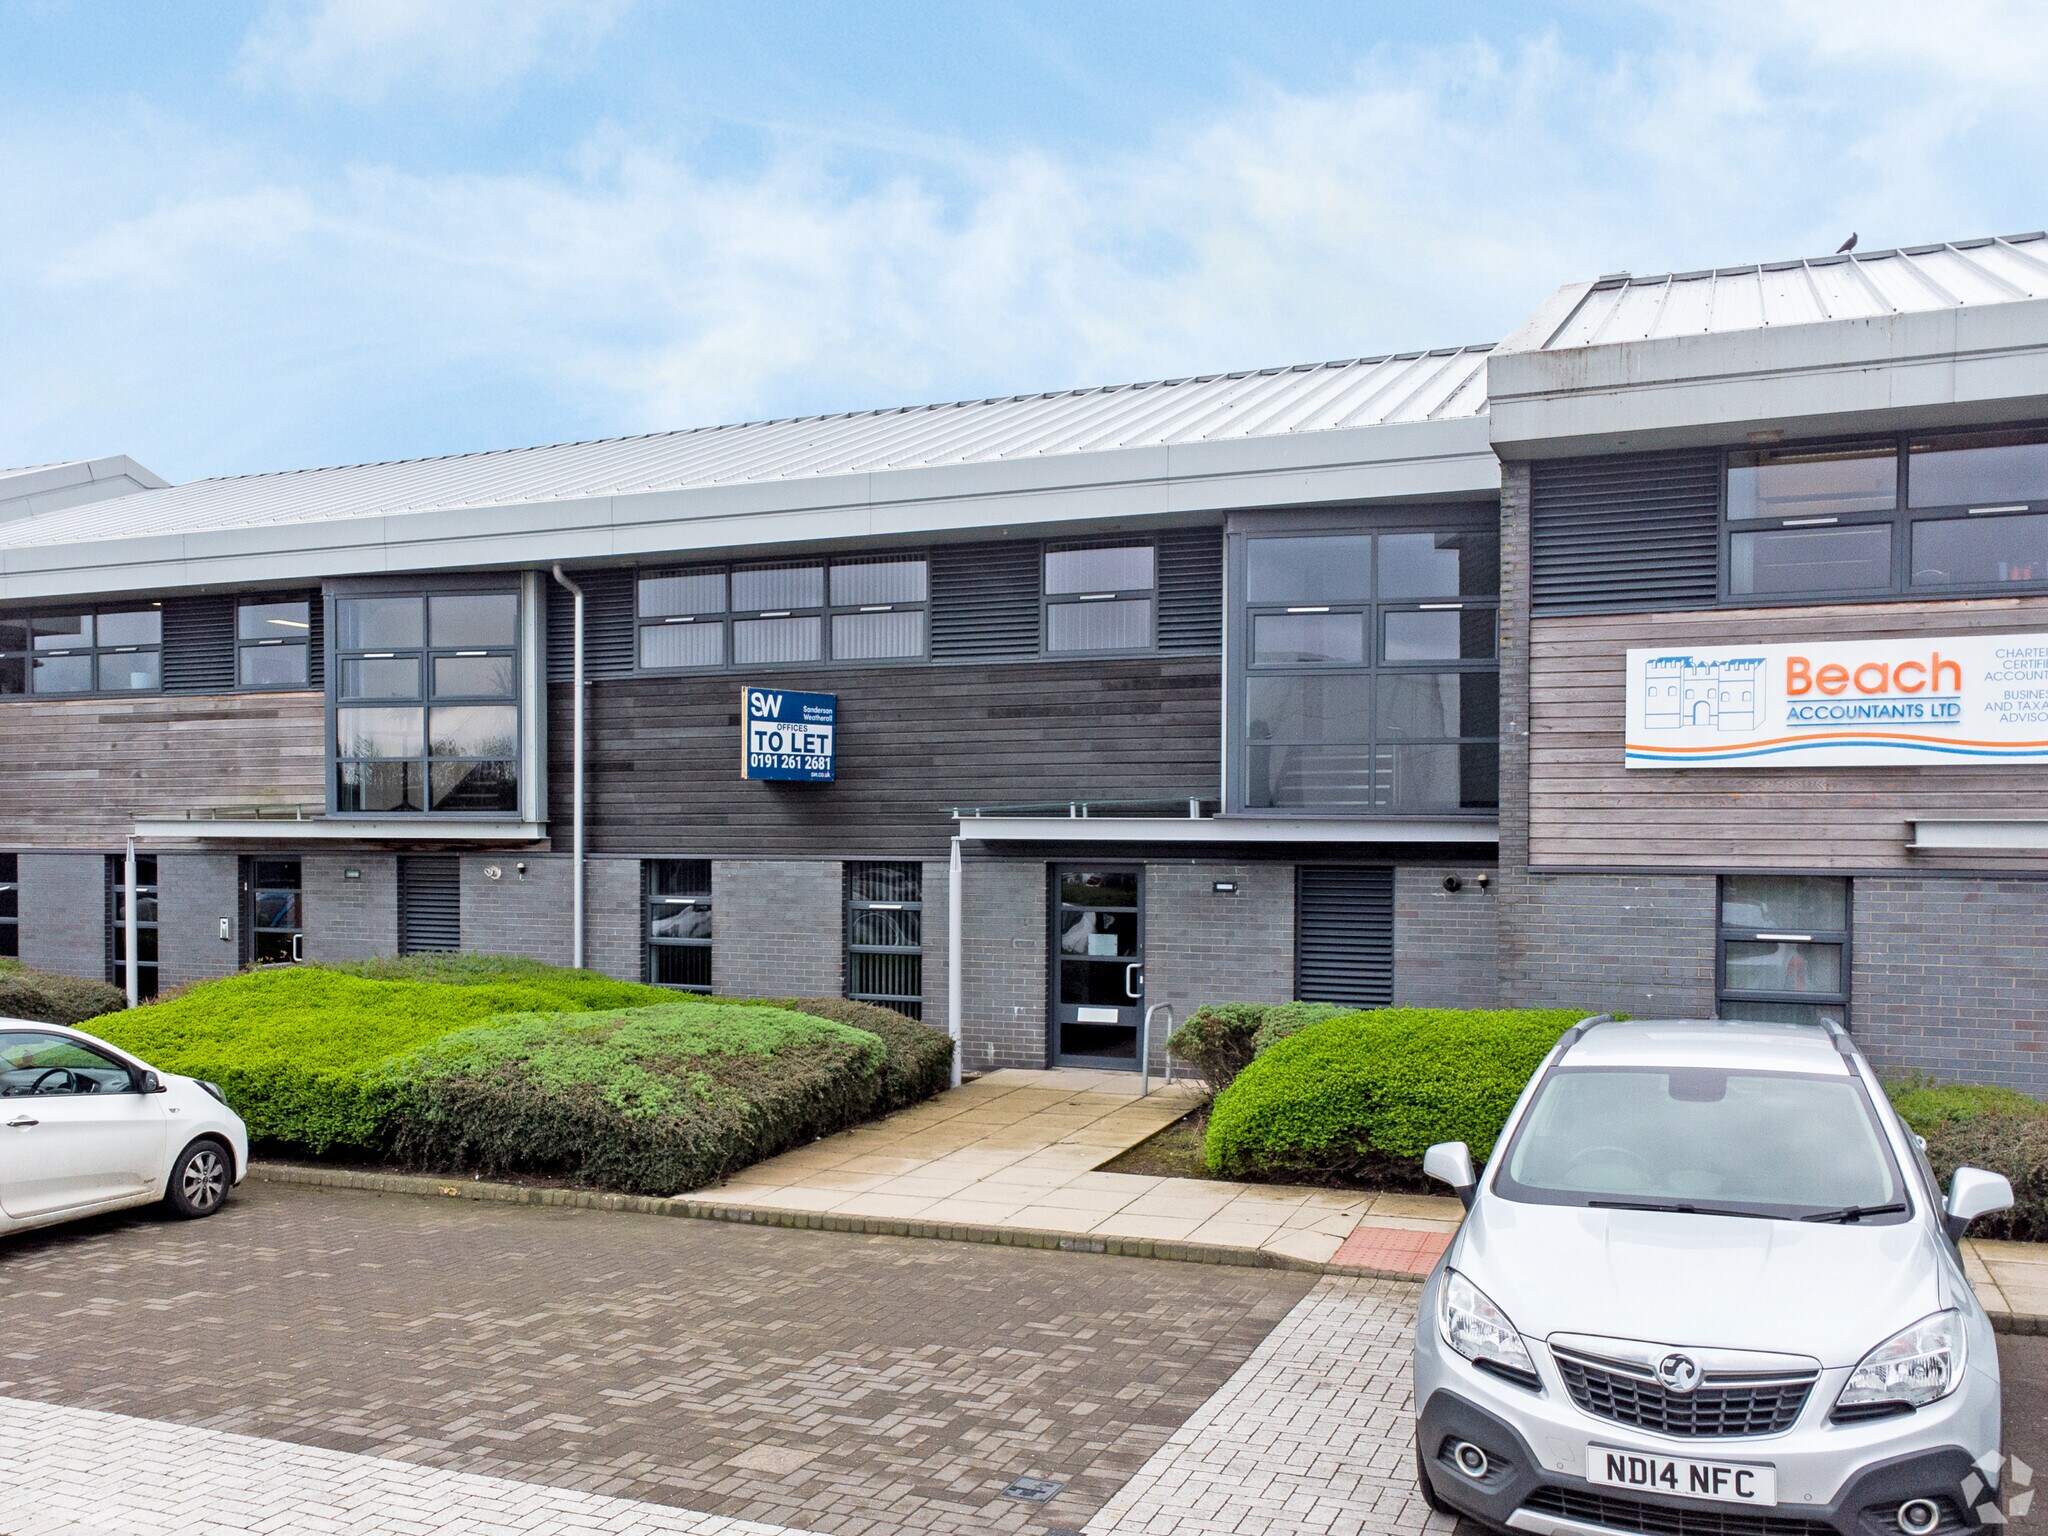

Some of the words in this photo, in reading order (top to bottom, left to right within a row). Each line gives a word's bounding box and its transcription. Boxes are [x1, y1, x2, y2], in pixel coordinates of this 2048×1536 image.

[1786, 651, 1962, 696] Beach
[751, 692, 782, 718] SW
[803, 706, 832, 714] Sanderson
[1786, 704, 1924, 720] ACCOUNTANTS
[1931, 703, 1962, 717] LTD
[1984, 701, 2013, 712] AND
[777, 724, 808, 732] OFFICES
[755, 731, 783, 752] TO
[791, 732, 829, 754] LET
[751, 753, 778, 768] 0191
[781, 754, 801, 769] 261
[804, 756, 831, 770] 2681
[1606, 1453, 1679, 1490] ND14
[1690, 1464, 1755, 1498] NFC
